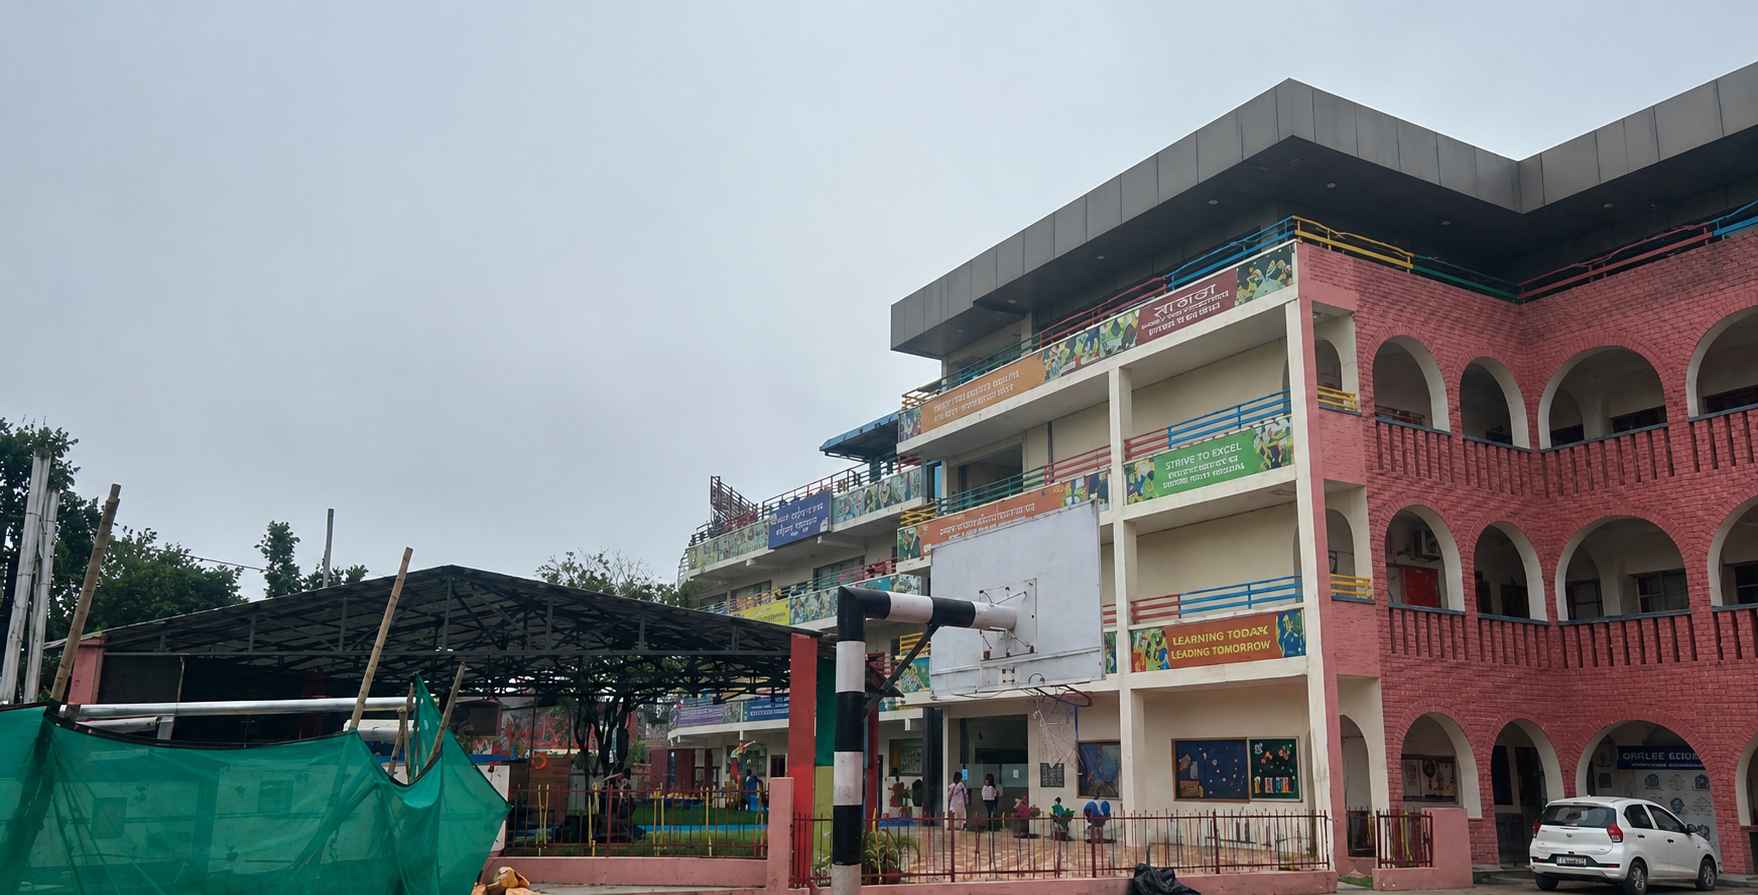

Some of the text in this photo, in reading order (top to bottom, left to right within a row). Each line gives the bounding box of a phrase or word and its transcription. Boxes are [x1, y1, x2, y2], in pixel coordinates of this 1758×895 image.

[1165, 456, 1195, 471] STRIVE
[1198, 451, 1210, 461] TO
[1212, 442, 1243, 457] EXCEL
[1172, 632, 1225, 646] LEARNING
[1171, 640, 1271, 660] LEADING TOMORROW
